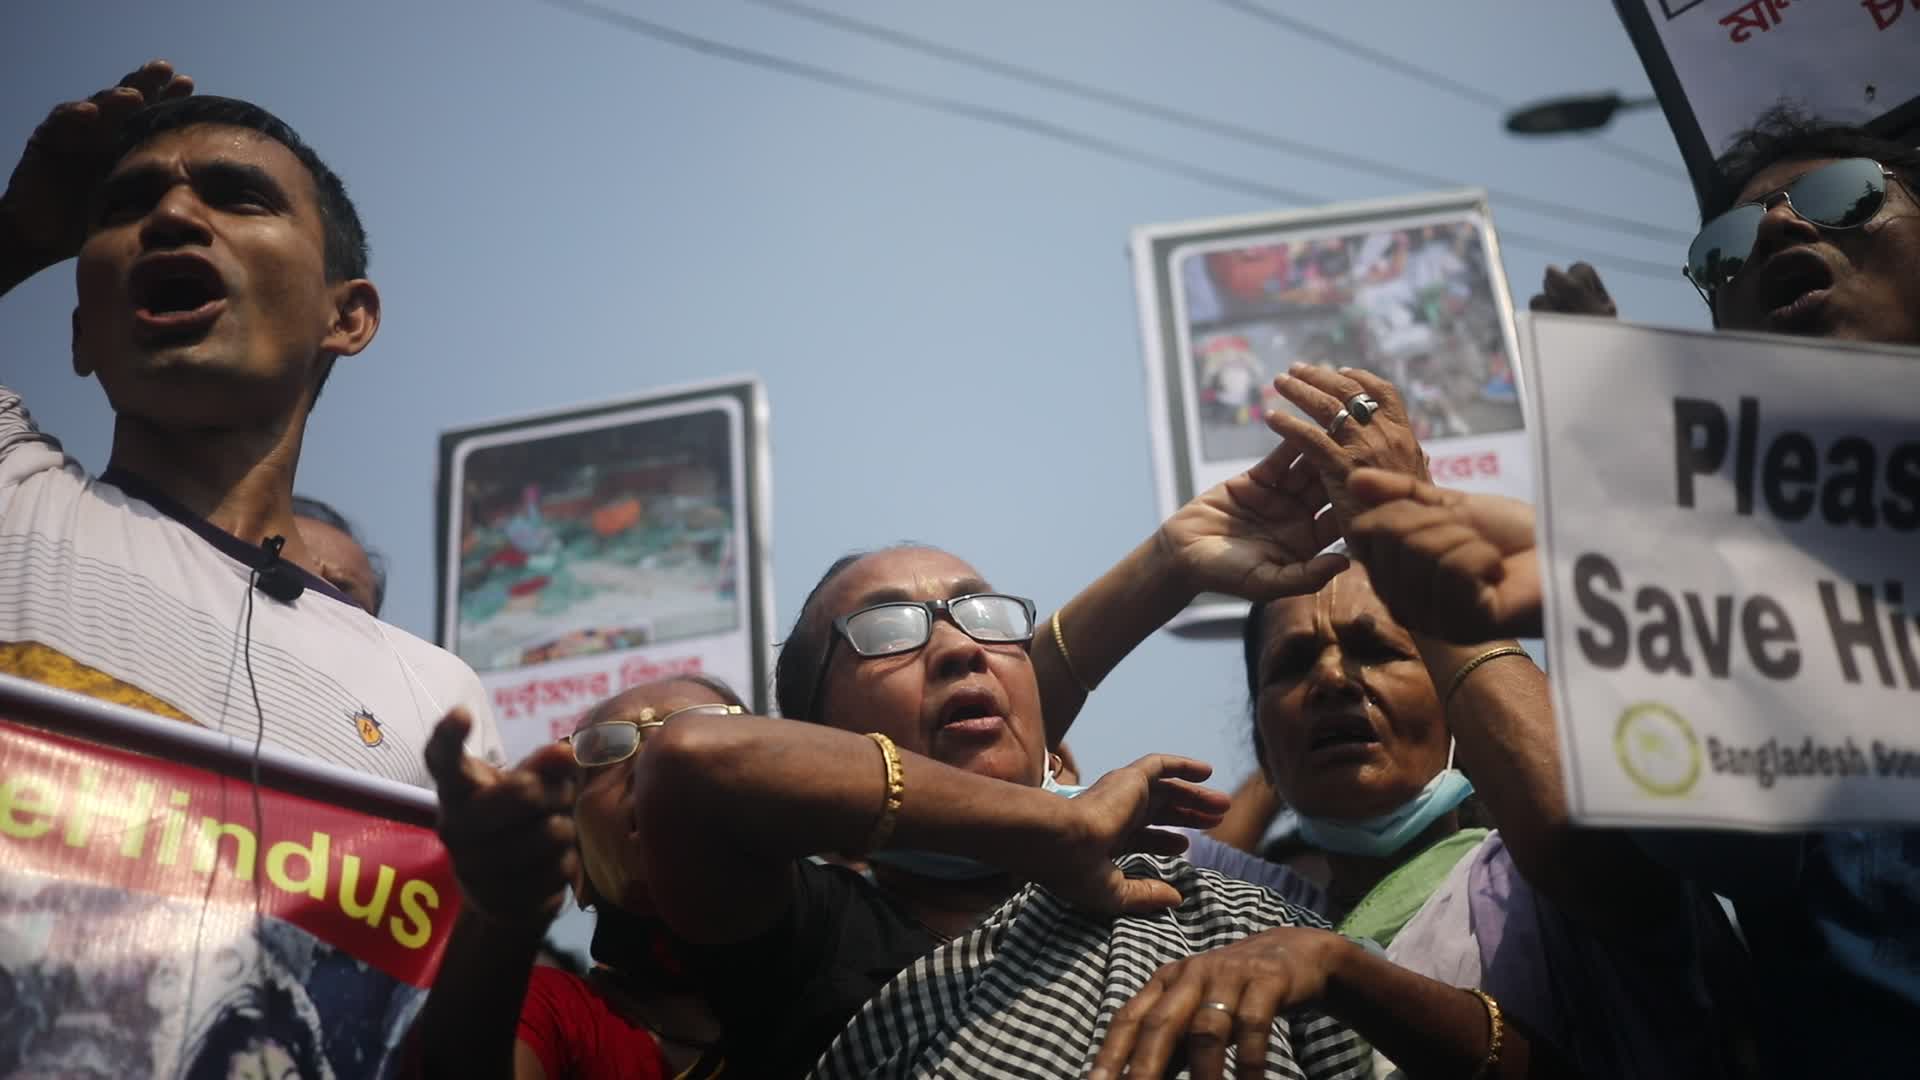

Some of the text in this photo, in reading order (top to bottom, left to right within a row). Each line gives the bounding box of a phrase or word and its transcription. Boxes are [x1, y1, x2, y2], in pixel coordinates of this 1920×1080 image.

[1573, 552, 1920, 691] Save Hi
[1707, 736, 1869, 789] Bangladesh
